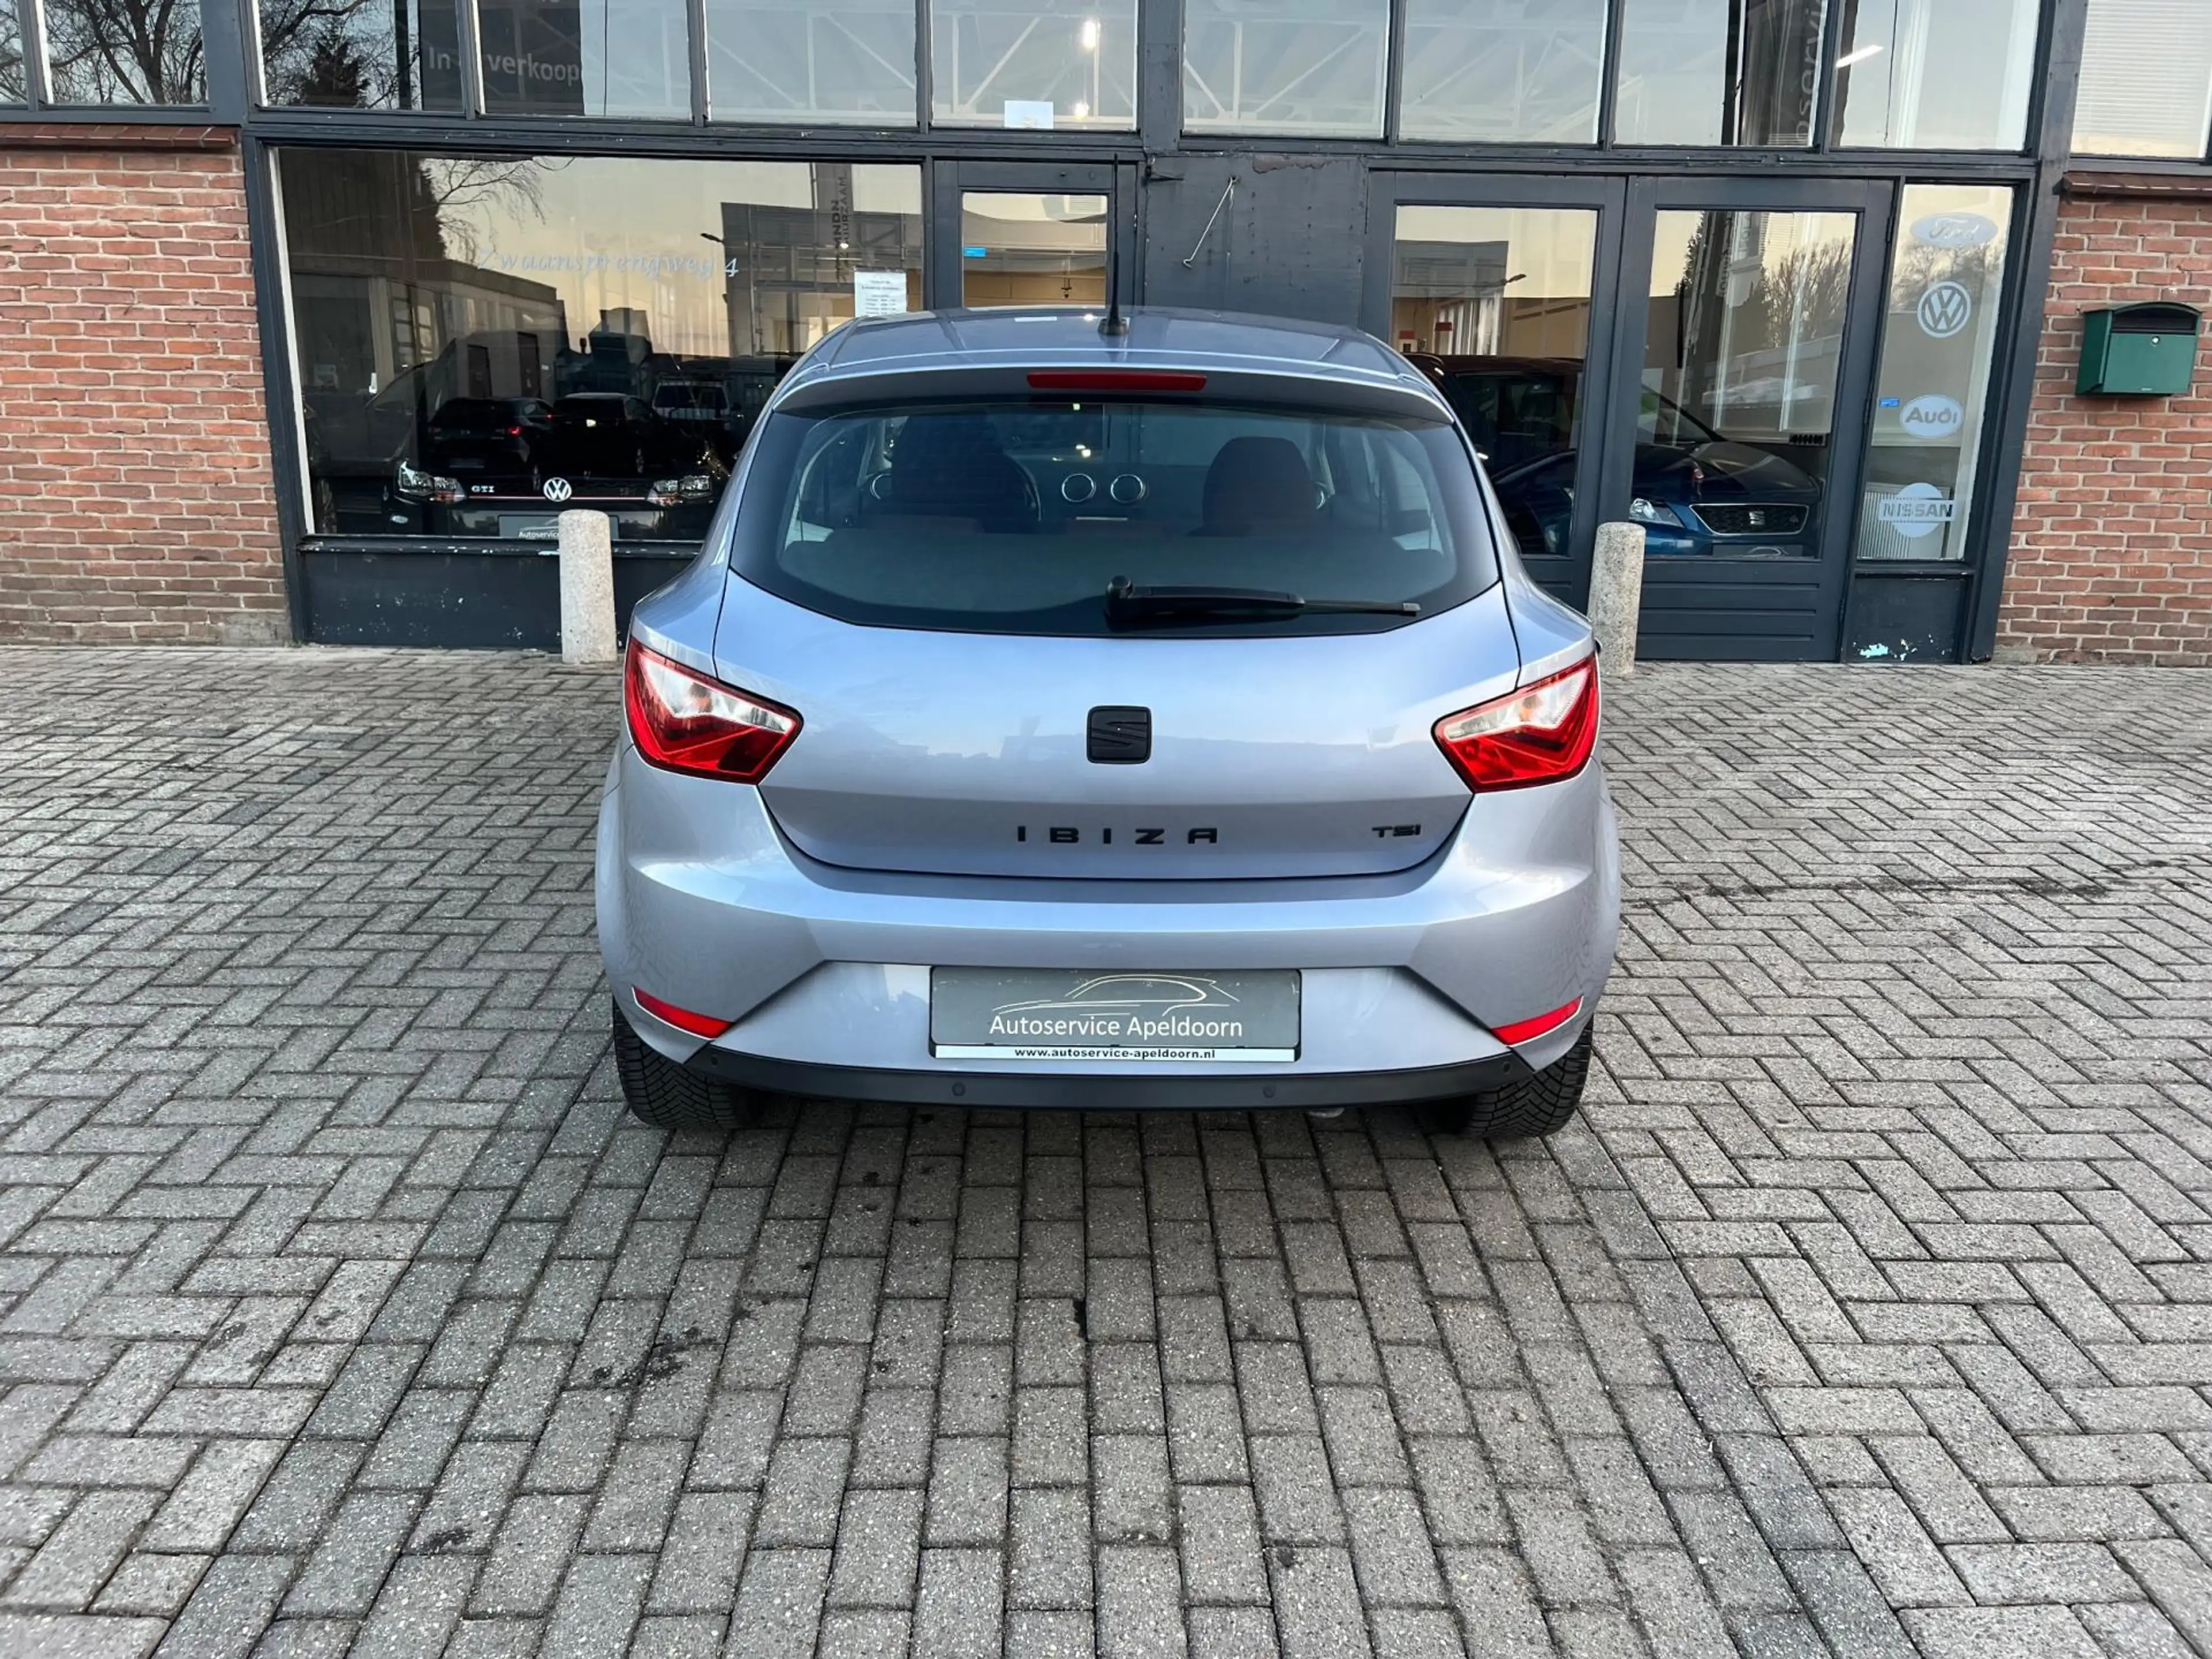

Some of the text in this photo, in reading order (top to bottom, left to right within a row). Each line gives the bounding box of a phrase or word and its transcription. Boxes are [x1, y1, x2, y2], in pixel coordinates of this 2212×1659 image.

[486, 53, 579, 86] verkoop
[724, 257, 739, 278] 4
[1904, 406, 1959, 425] Audi
[471, 485, 495, 493] GTI
[1883, 502, 1954, 517] NISSAN
[1017, 825, 1218, 845] IBIZA
[1372, 823, 1421, 838] TSI
[988, 1015, 1243, 1041] Autoservice Apeldoorn
[1014, 1048, 1215, 1060] www.autoservice-apeldoorn.nl
